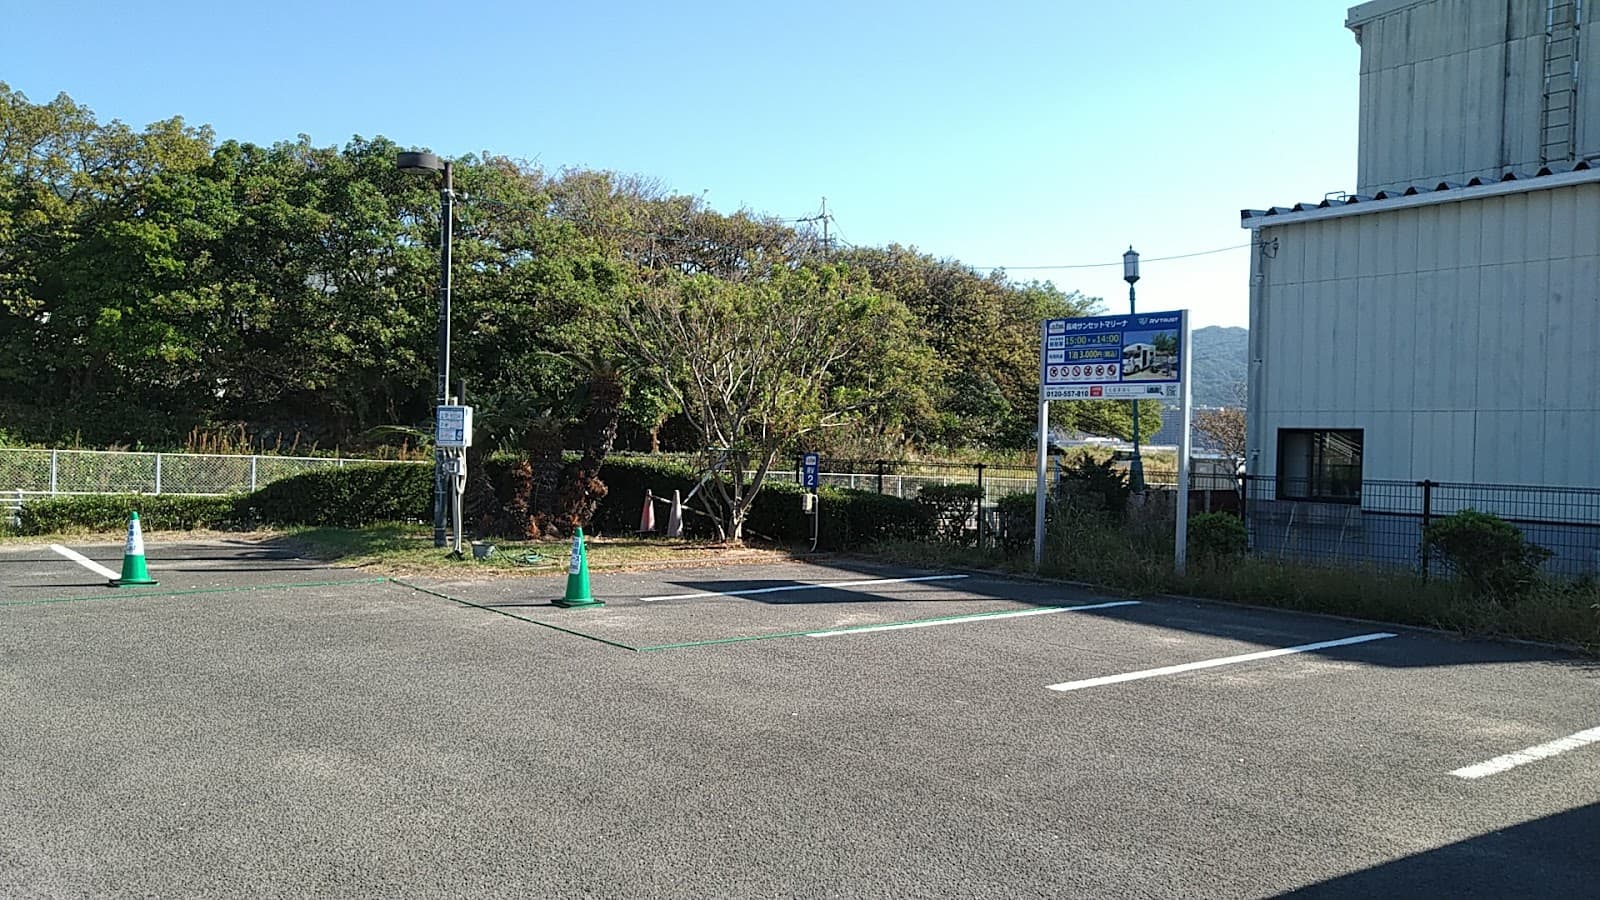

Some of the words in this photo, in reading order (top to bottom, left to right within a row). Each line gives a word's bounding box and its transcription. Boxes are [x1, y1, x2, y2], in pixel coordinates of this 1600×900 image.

[1066, 336, 1087, 345] 15:00
[1046, 390, 1089, 398] 0120-557-810
[808, 475, 814, 485] 2
